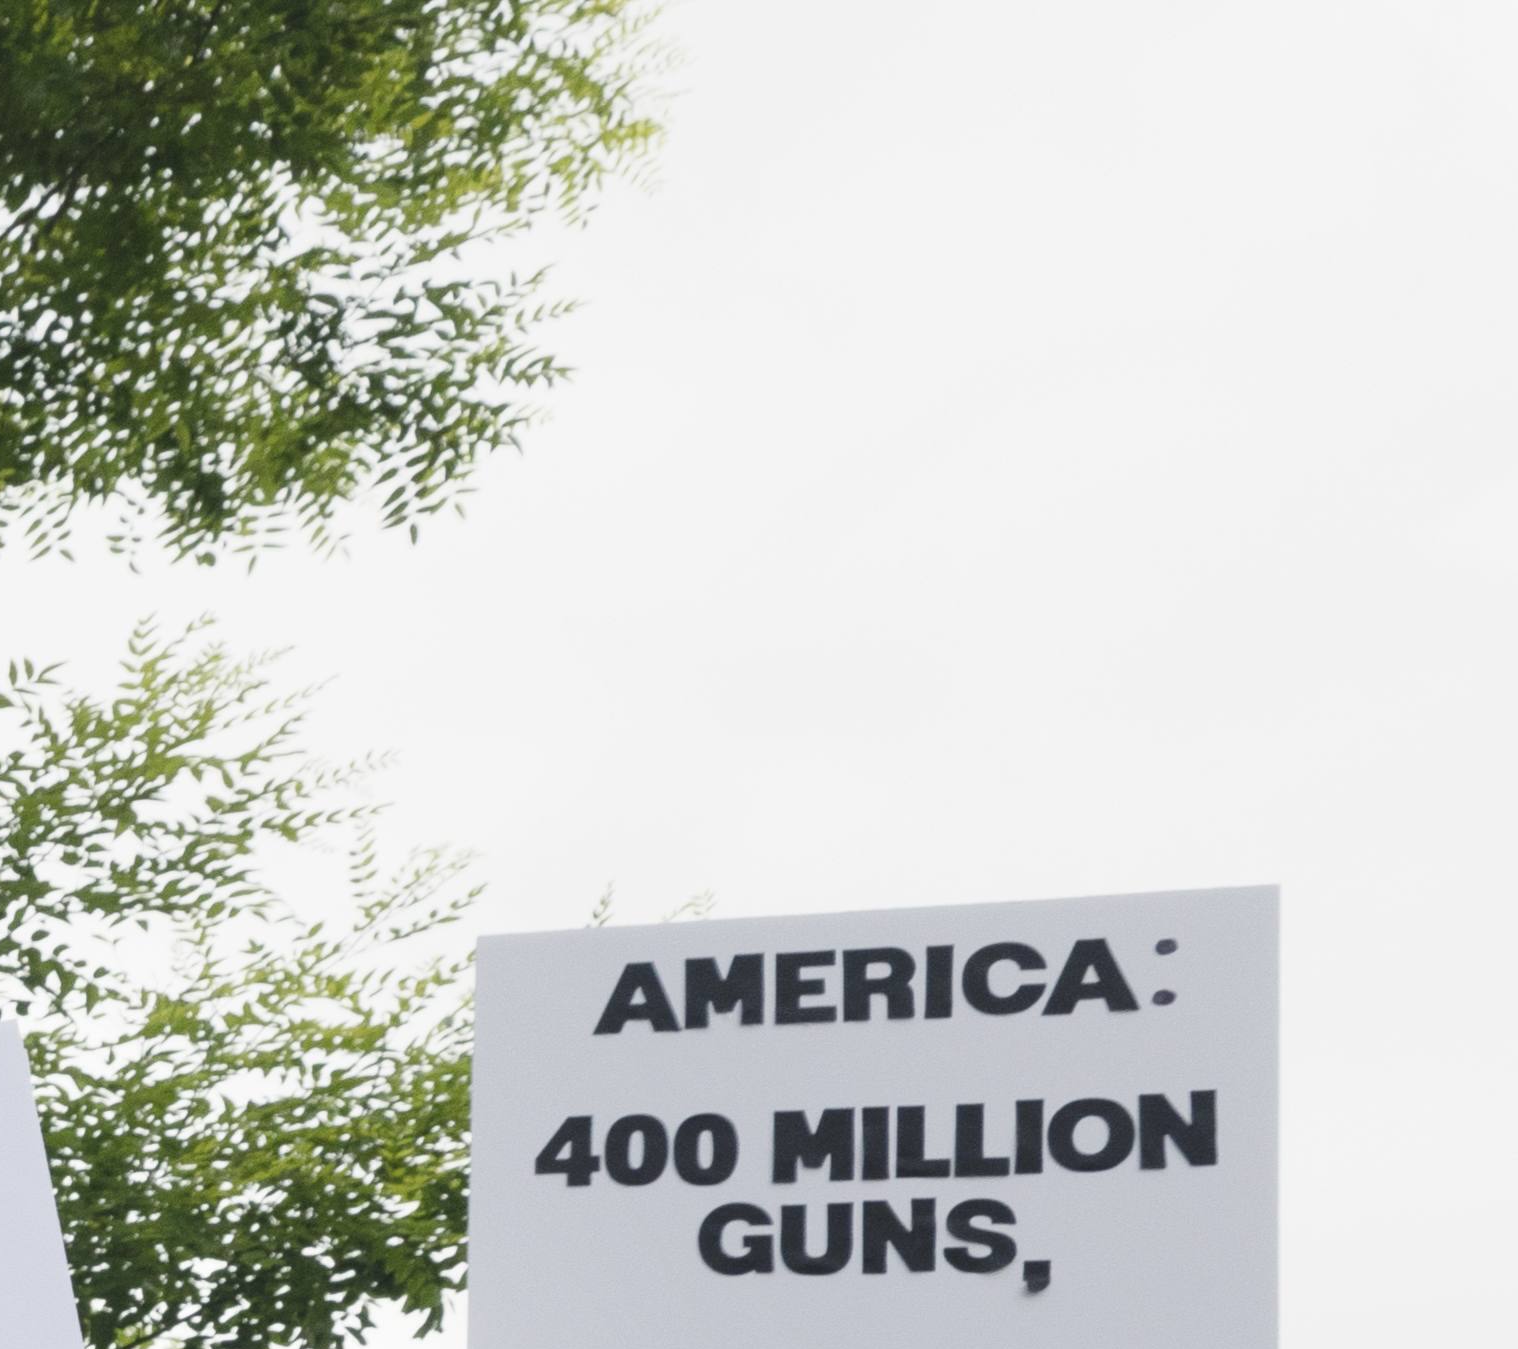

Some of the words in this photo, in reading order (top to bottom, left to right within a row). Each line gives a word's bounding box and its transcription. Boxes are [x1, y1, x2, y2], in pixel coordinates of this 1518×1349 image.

[591, 936, 1181, 1036] AMERICA:
[533, 1111, 740, 1189] 400
[770, 1088, 1219, 1185] MILLION
[696, 1196, 1053, 1296] GUNS,
